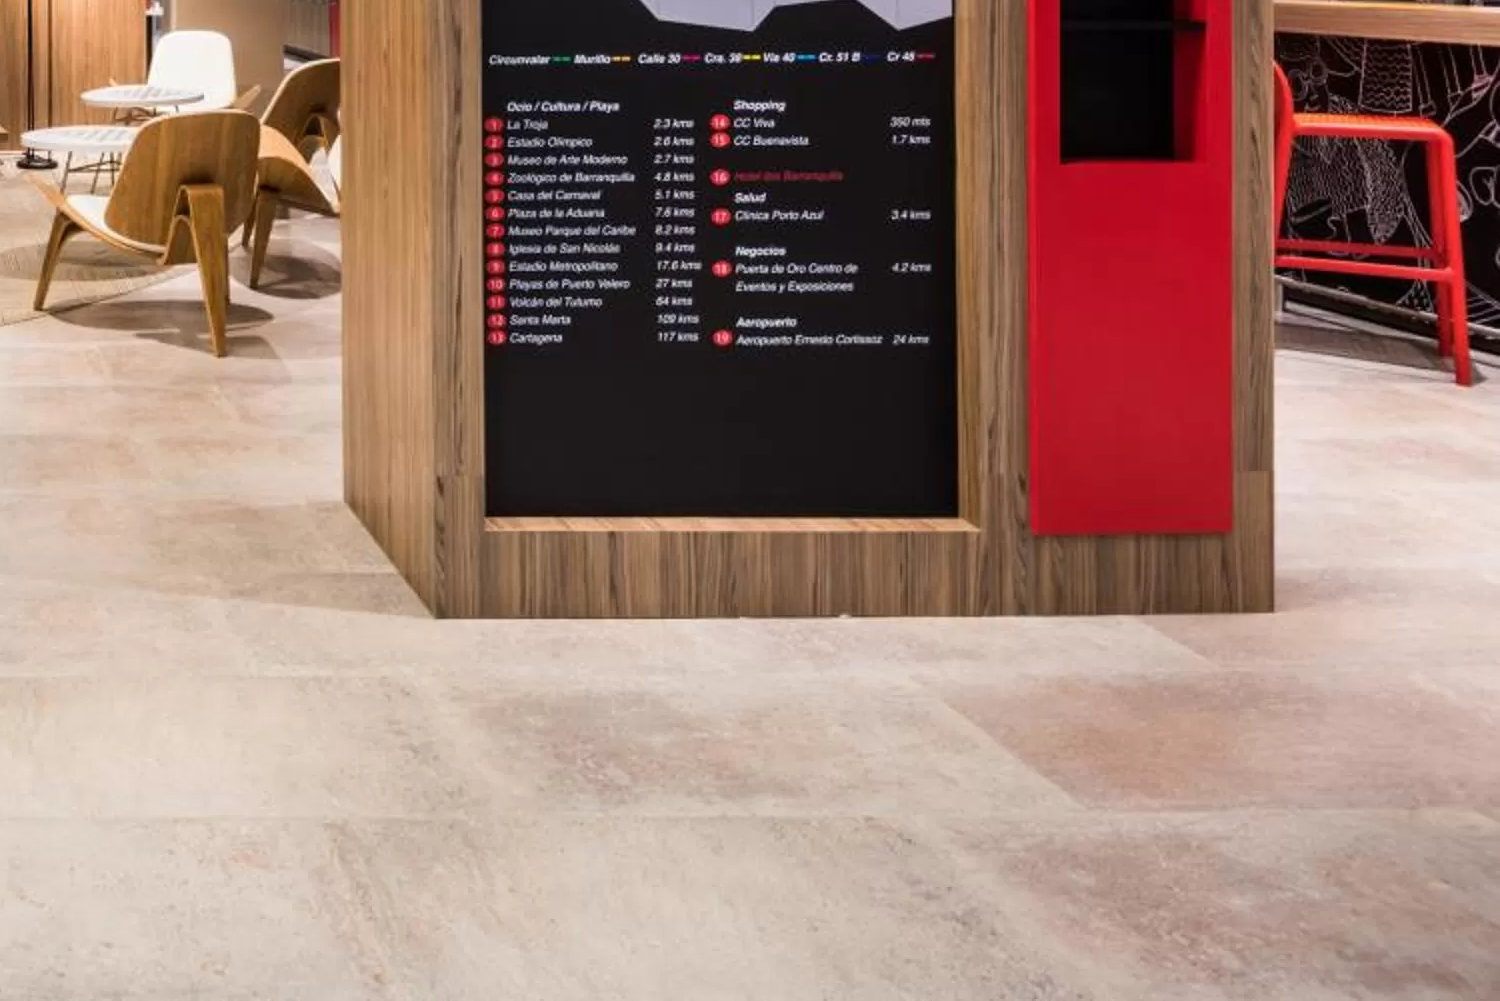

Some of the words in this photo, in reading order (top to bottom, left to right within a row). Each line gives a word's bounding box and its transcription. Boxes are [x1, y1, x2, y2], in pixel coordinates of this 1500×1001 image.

[489, 54, 551, 66] Circunvalar
[573, 54, 611, 65] Murillo
[637, 53, 667, 65] Calle
[835, 52, 850, 63] 51
[507, 101, 534, 112] Ocio
[541, 101, 581, 112] Cultura
[589, 101, 620, 114] Playa
[733, 99, 786, 113] Shopping
[507, 120, 521, 130] La
[672, 118, 694, 129] kms
[733, 117, 750, 128] CC
[753, 117, 775, 128] Viva
[507, 137, 546, 148] Estadio
[672, 136, 694, 147] kms
[734, 135, 750, 146] CC
[753, 135, 809, 146] Buenavista
[909, 134, 931, 144] kms
[508, 155, 542, 166] Museo
[543, 155, 557, 165] de
[558, 155, 581, 165] Arte
[583, 154, 628, 165] Moderno
[672, 153, 694, 164] kms
[559, 173, 572, 183] de
[575, 172, 635, 185] Barranquilla
[672, 172, 694, 182] kms
[508, 191, 534, 201] Casa
[536, 190, 553, 200] del
[555, 190, 601, 200] Carnaval
[673, 189, 694, 200] kms
[734, 192, 767, 204] Salud
[508, 208, 536, 218] Plaza
[539, 208, 553, 218] de
[555, 208, 565, 218] la
[565, 207, 604, 218] Aduana
[673, 207, 694, 217] kms
[772, 210, 799, 220] Porto
[801, 210, 824, 220] Azul
[909, 210, 931, 220] kms
[508, 226, 543, 236] Museo
[545, 225, 581, 238] Parque
[583, 225, 600, 235] del
[602, 225, 636, 236] Caribe
[673, 225, 695, 235] kms
[509, 244, 543, 256] Iglesia
[543, 243, 557, 253] de
[560, 243, 581, 253] San
[673, 242, 695, 253] kms
[735, 246, 787, 259] Negocios
[509, 261, 547, 272] Estadio
[549, 261, 618, 274] Metropolitano
[680, 260, 702, 270] kms
[735, 263, 768, 274] Puerta
[771, 264, 784, 274] de
[786, 263, 806, 274] Oro
[808, 263, 842, 273] Centro
[843, 264, 858, 274] de
[909, 262, 931, 272] kms
[509, 279, 543, 291] Playas
[545, 279, 559, 289] de
[561, 279, 596, 289] Puerto
[598, 279, 631, 289] Velero
[671, 278, 693, 289] kms
[735, 281, 776, 292] Eventos
[777, 283, 785, 293] y
[787, 280, 854, 293] Exposiciones
[546, 297, 563, 307] del
[671, 296, 693, 306] kms
[510, 315, 540, 326] Santa
[542, 314, 571, 325] Marta
[677, 313, 699, 324] kms
[736, 317, 797, 329] Aeropuerto
[510, 333, 563, 346] Cartagena
[677, 331, 699, 342] kms
[735, 335, 792, 347] Aeropuerto
[908, 334, 930, 344] kms
